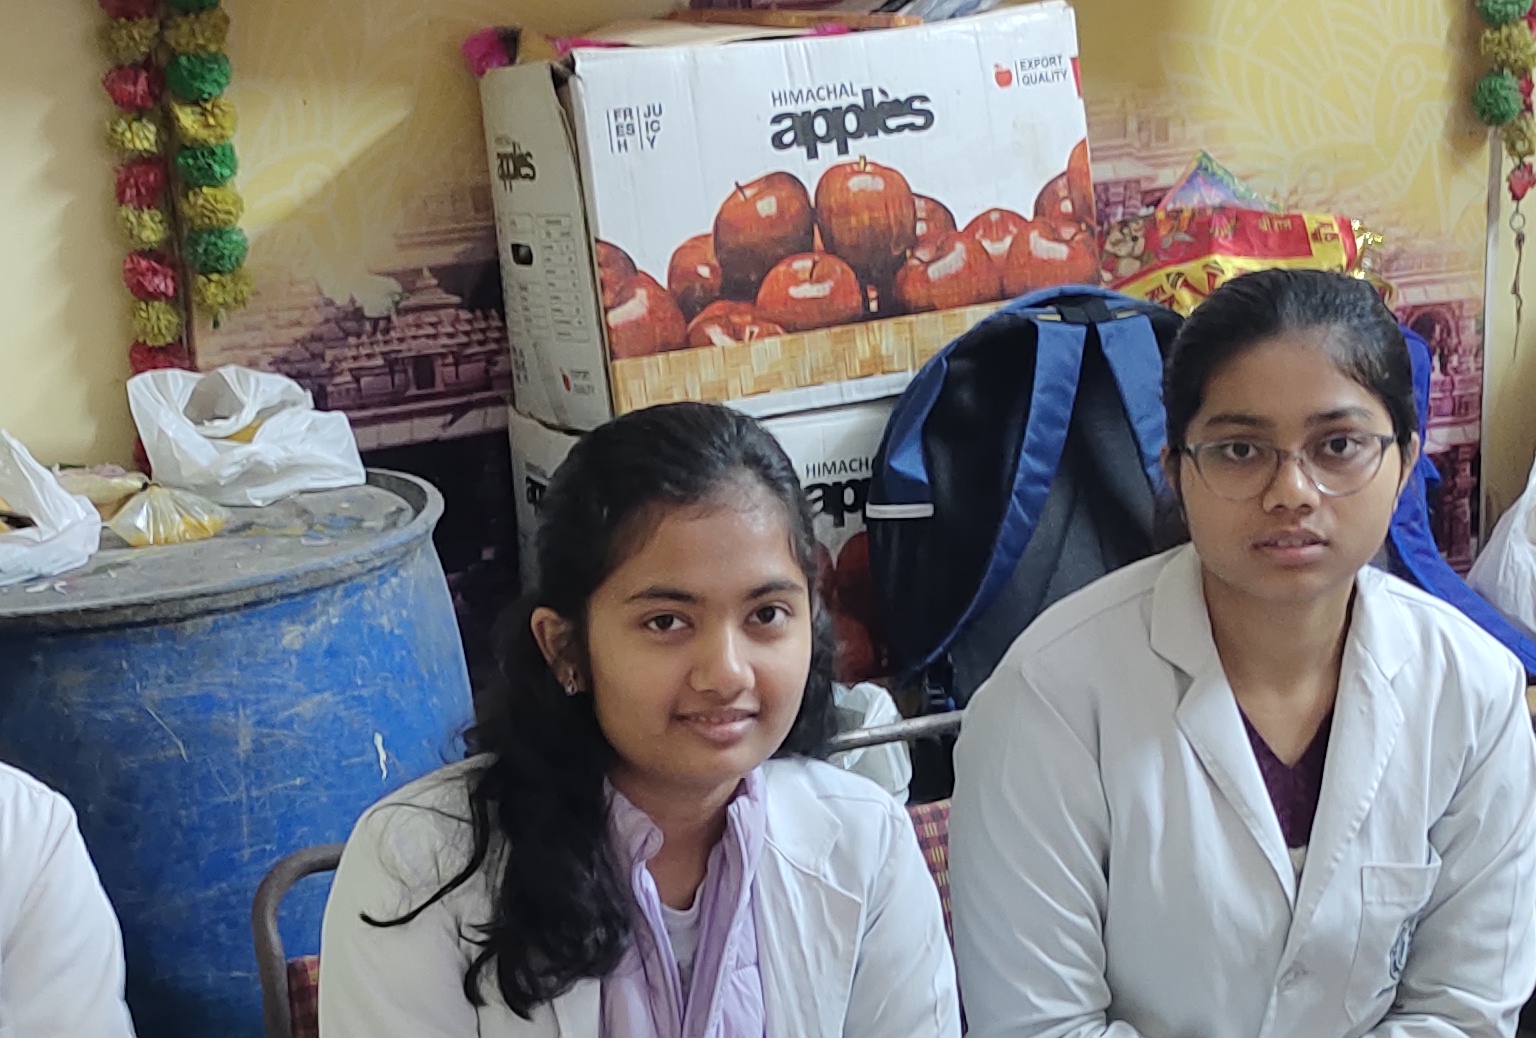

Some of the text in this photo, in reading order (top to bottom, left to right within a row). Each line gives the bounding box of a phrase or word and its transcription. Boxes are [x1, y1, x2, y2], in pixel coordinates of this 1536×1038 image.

[1020, 56, 1063, 71] EXPORT
[1021, 69, 1068, 85] QUALITY
[770, 82, 859, 107] HIMACHAL
[806, 457, 869, 479] HIMACH
